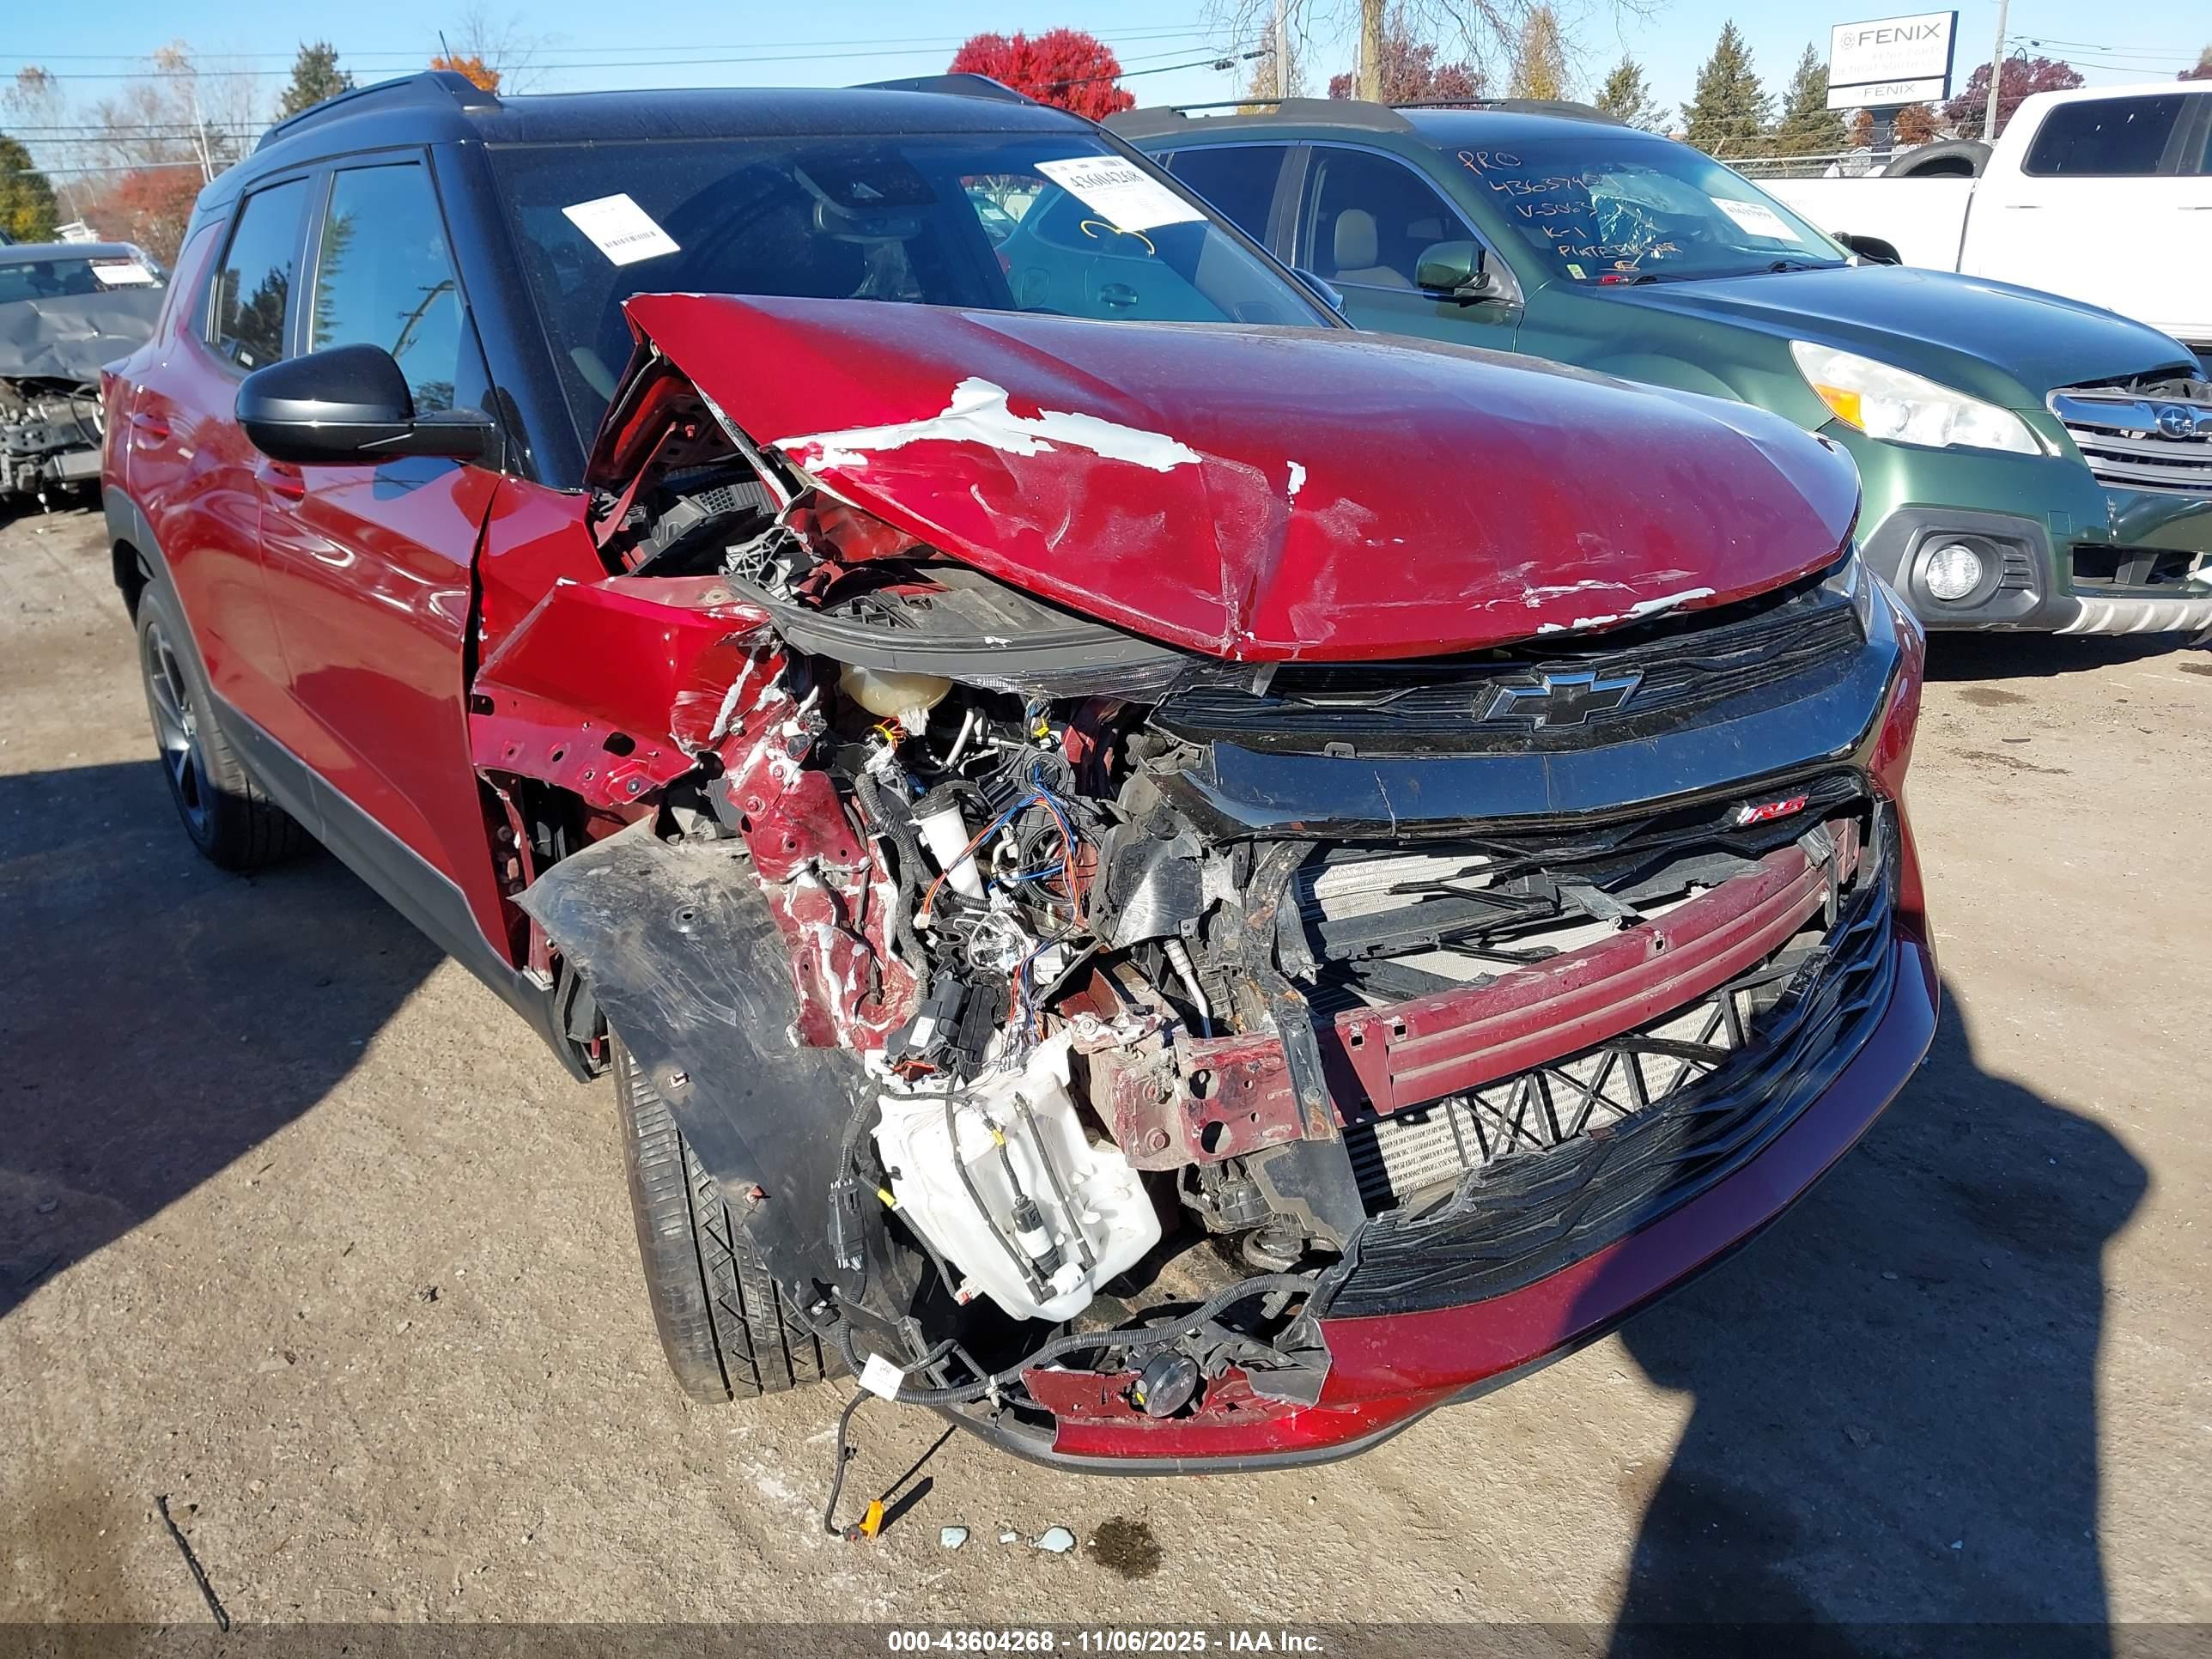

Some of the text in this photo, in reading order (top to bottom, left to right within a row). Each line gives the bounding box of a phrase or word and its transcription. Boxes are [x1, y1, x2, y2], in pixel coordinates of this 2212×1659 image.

[1859, 23, 1941, 46] FENIX
[1865, 84, 1915, 97] FENIX
[1070, 170, 1144, 189] 43604268
[1542, 225, 1587, 238] K-1
